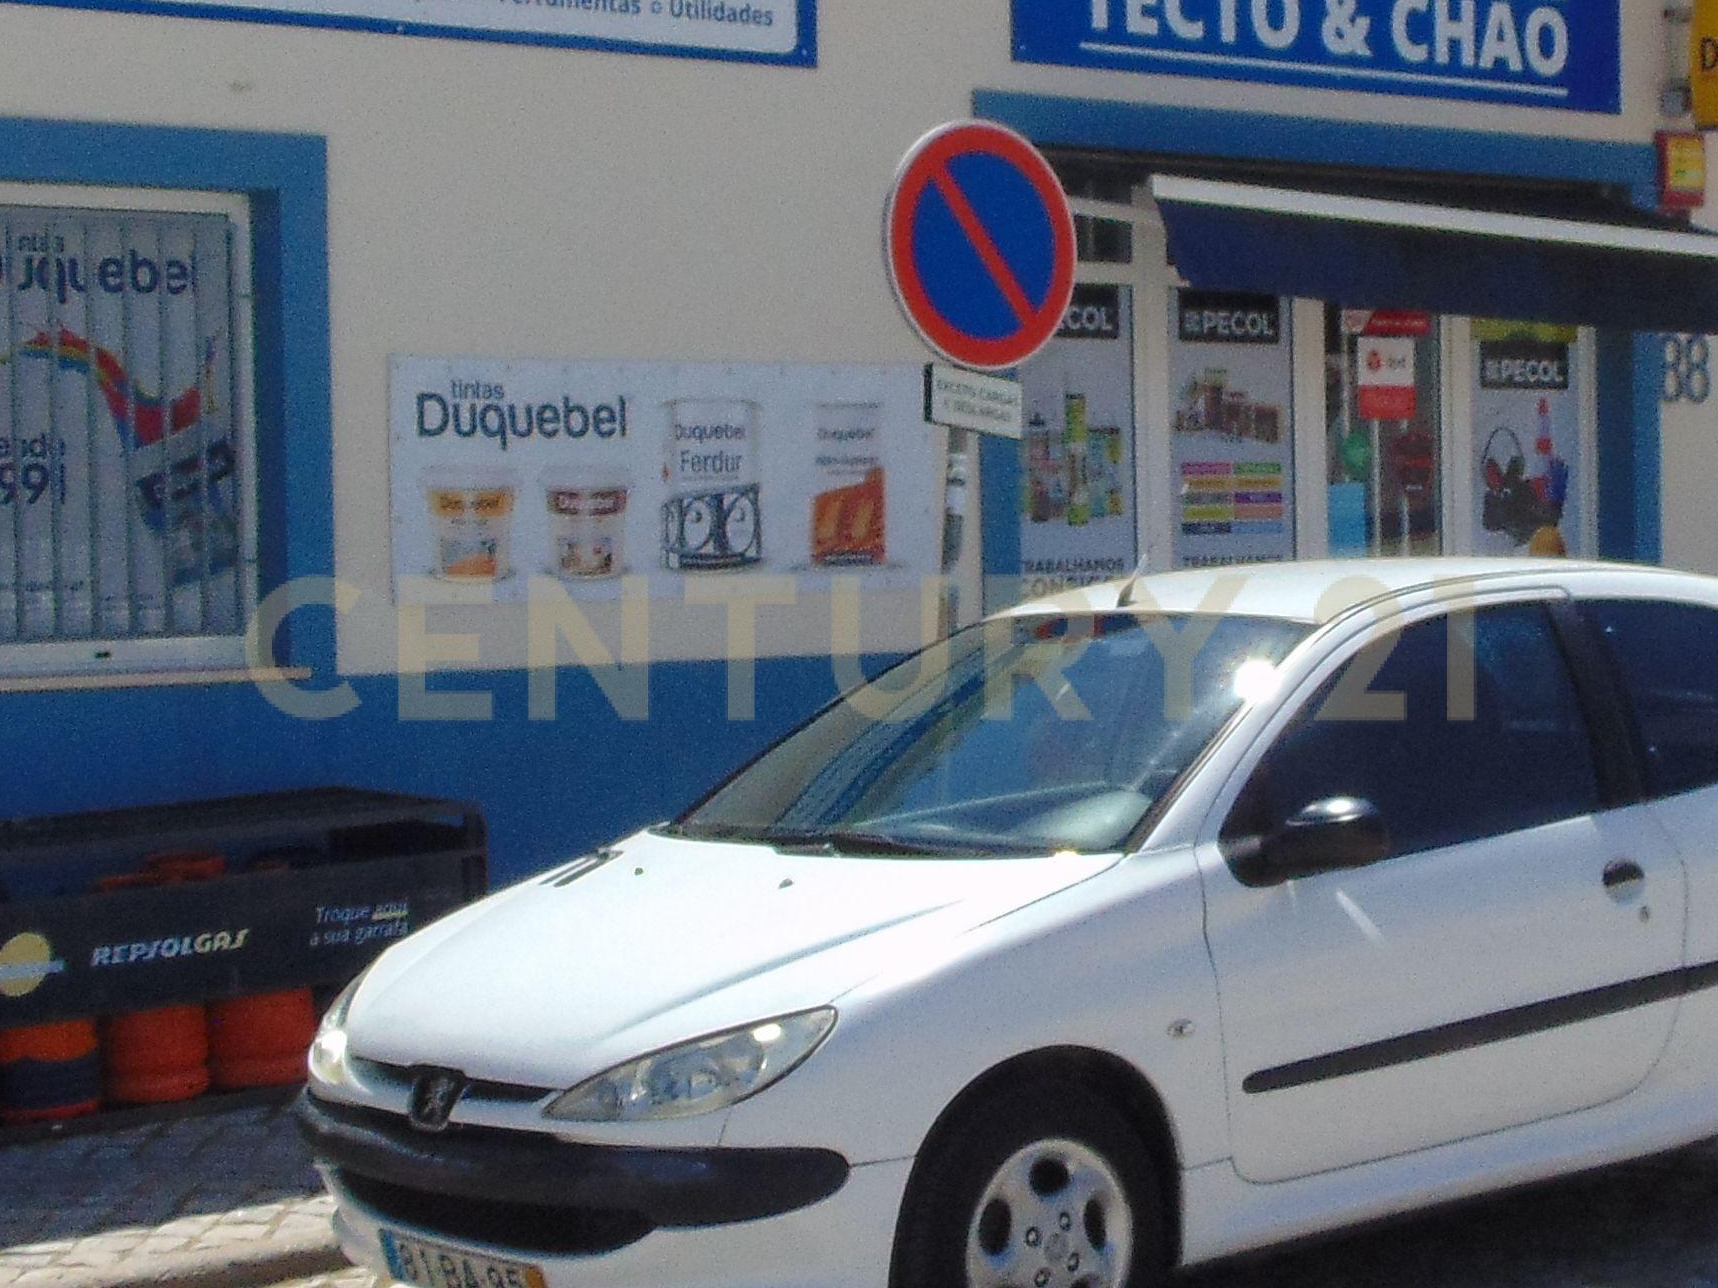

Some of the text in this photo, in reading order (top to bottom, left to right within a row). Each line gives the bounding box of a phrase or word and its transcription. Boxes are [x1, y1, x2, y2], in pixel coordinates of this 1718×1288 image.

[1202, 307, 1274, 337] PECOL
[1500, 360, 1564, 384] PECOL
[1664, 332, 1711, 404] 88
[450, 378, 506, 401] tintas
[416, 391, 628, 452] Duquebel
